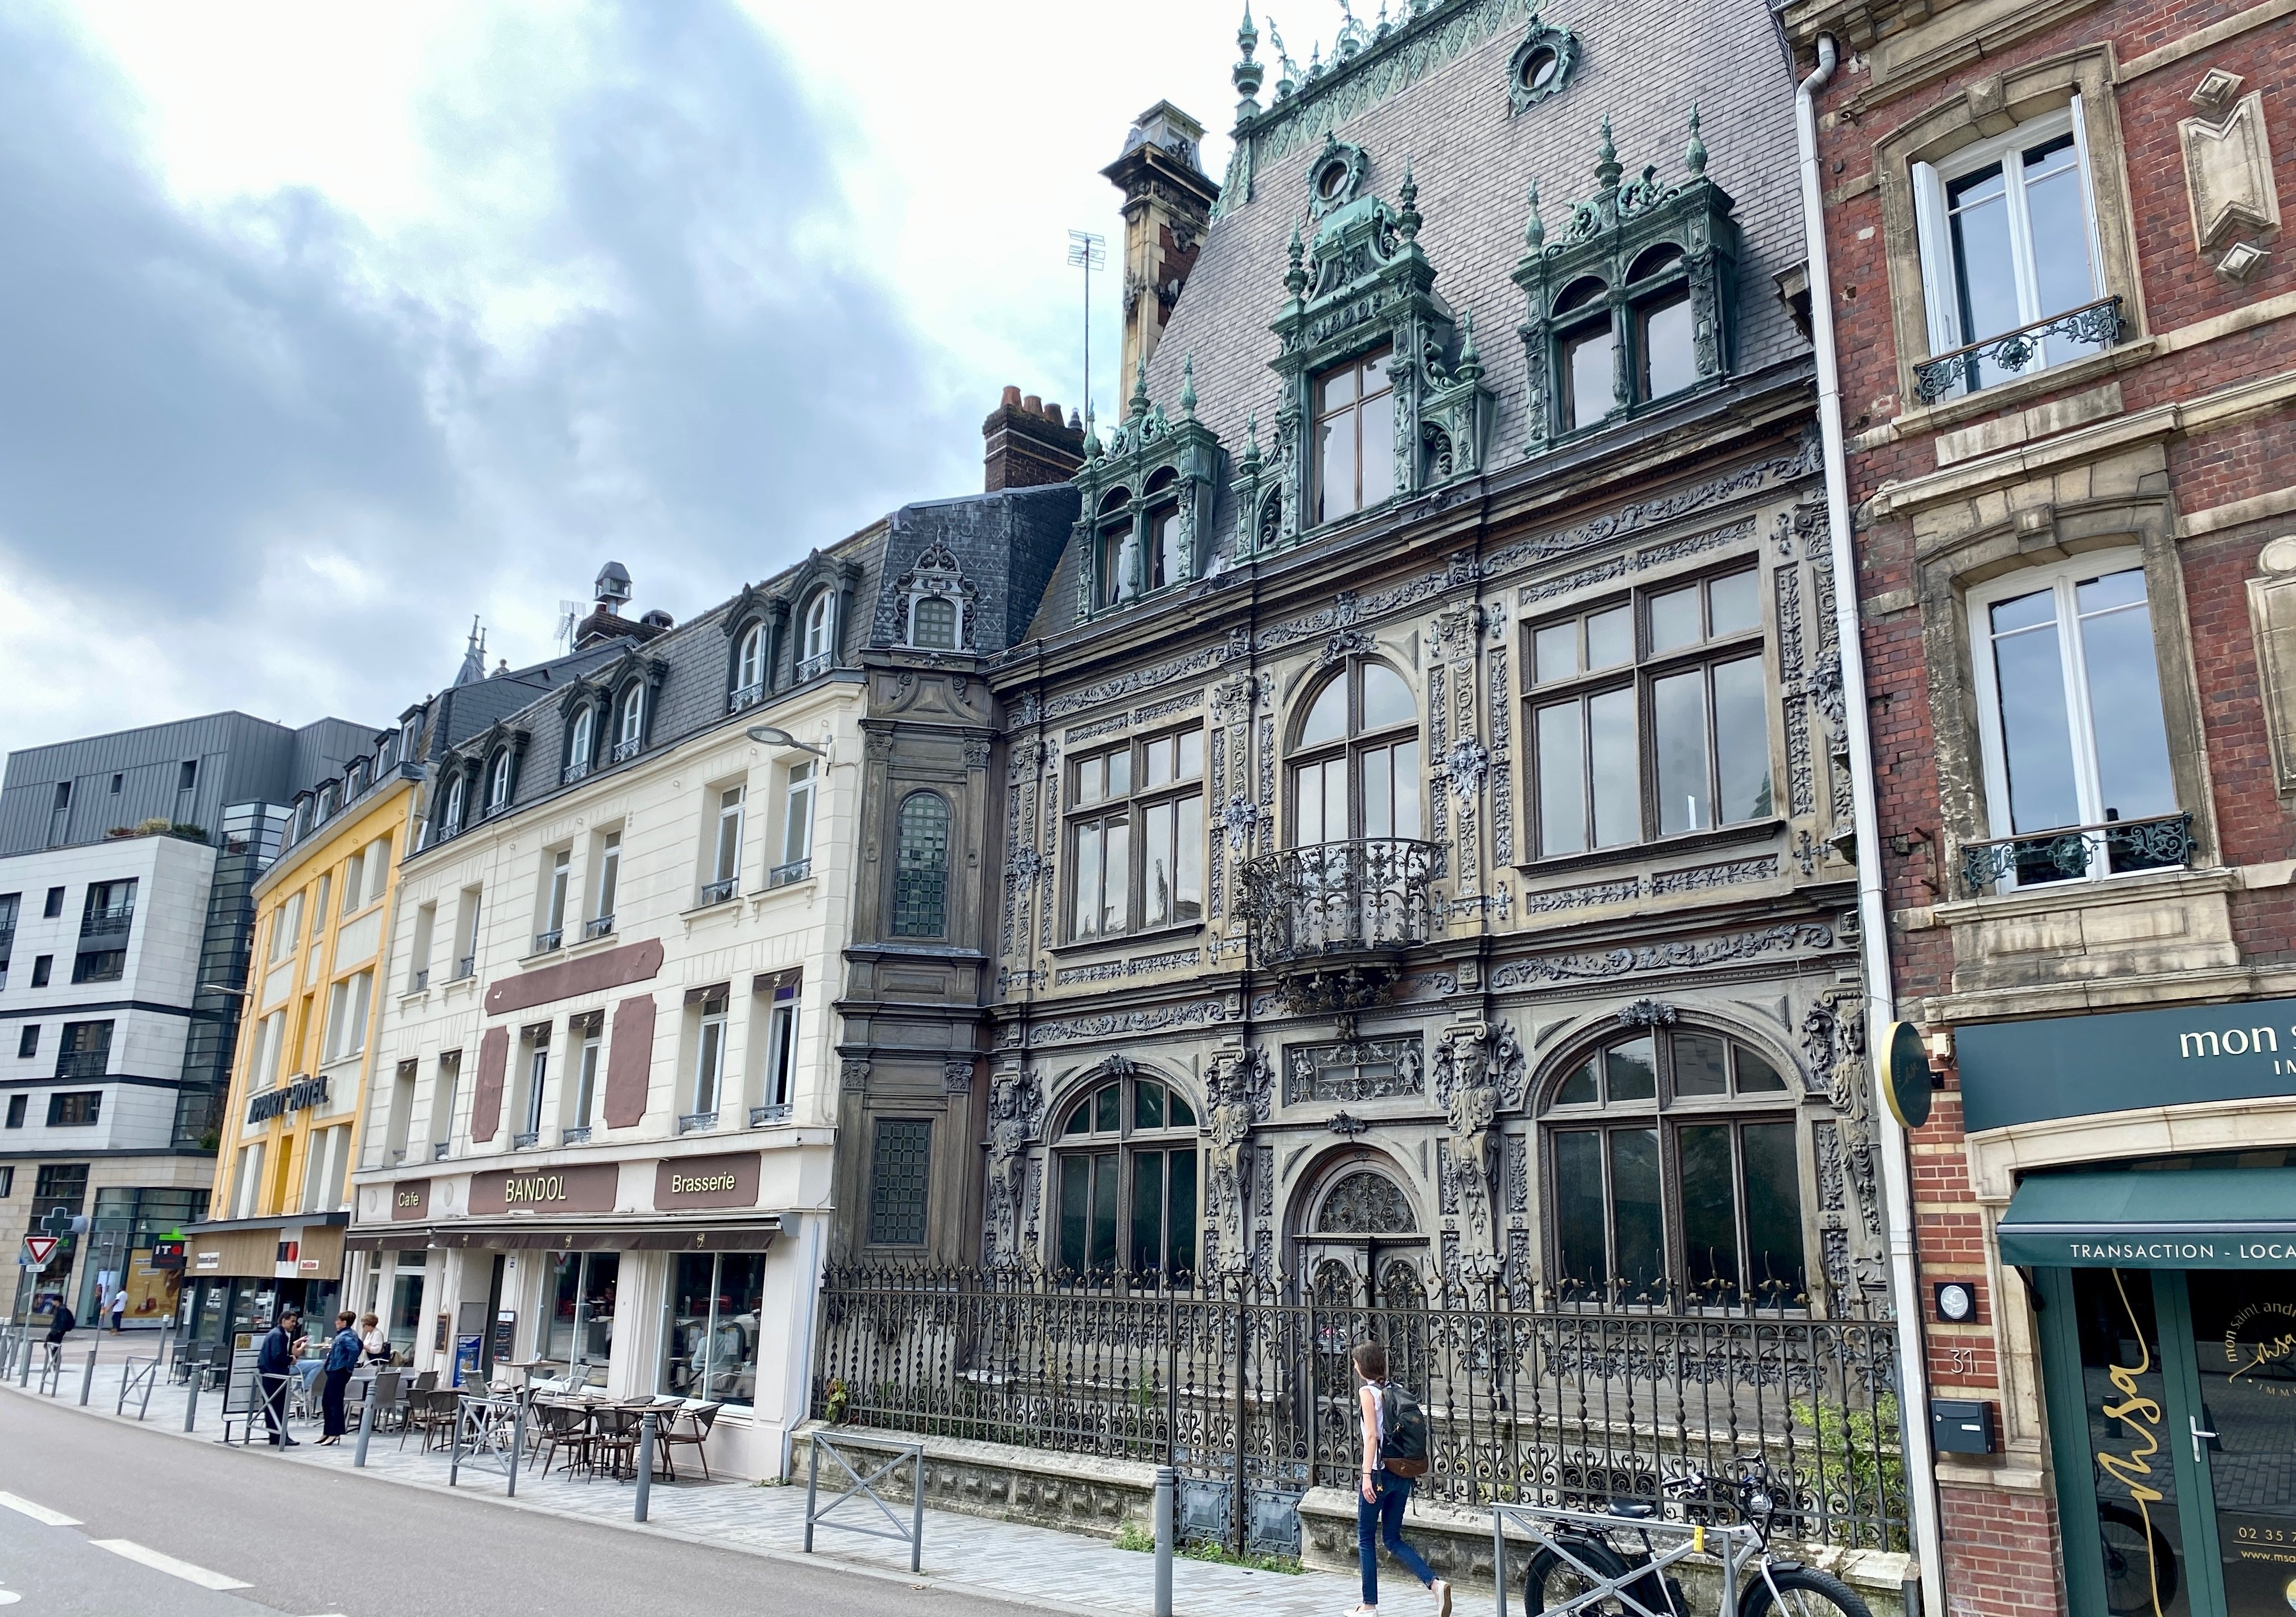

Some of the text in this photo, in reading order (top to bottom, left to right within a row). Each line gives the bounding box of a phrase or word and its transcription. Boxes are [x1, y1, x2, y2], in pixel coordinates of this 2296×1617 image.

[2179, 1027, 2278, 1058] mon
[505, 1176, 567, 1203] BANDOL
[672, 1171, 735, 1193] Brasserie
[398, 1191, 419, 1206] Cafe
[155, 1245, 182, 1255] ITO
[2070, 1244, 2213, 1259] TRANSACTION
[2240, 1244, 2296, 1259] LOCA
[2231, 1303, 2261, 1329] saint
[2225, 1330, 2238, 1362] mon
[1950, 1349, 1974, 1374] 31
[2238, 1527, 2257, 1539] 02
[2265, 1529, 2283, 1541] 35
